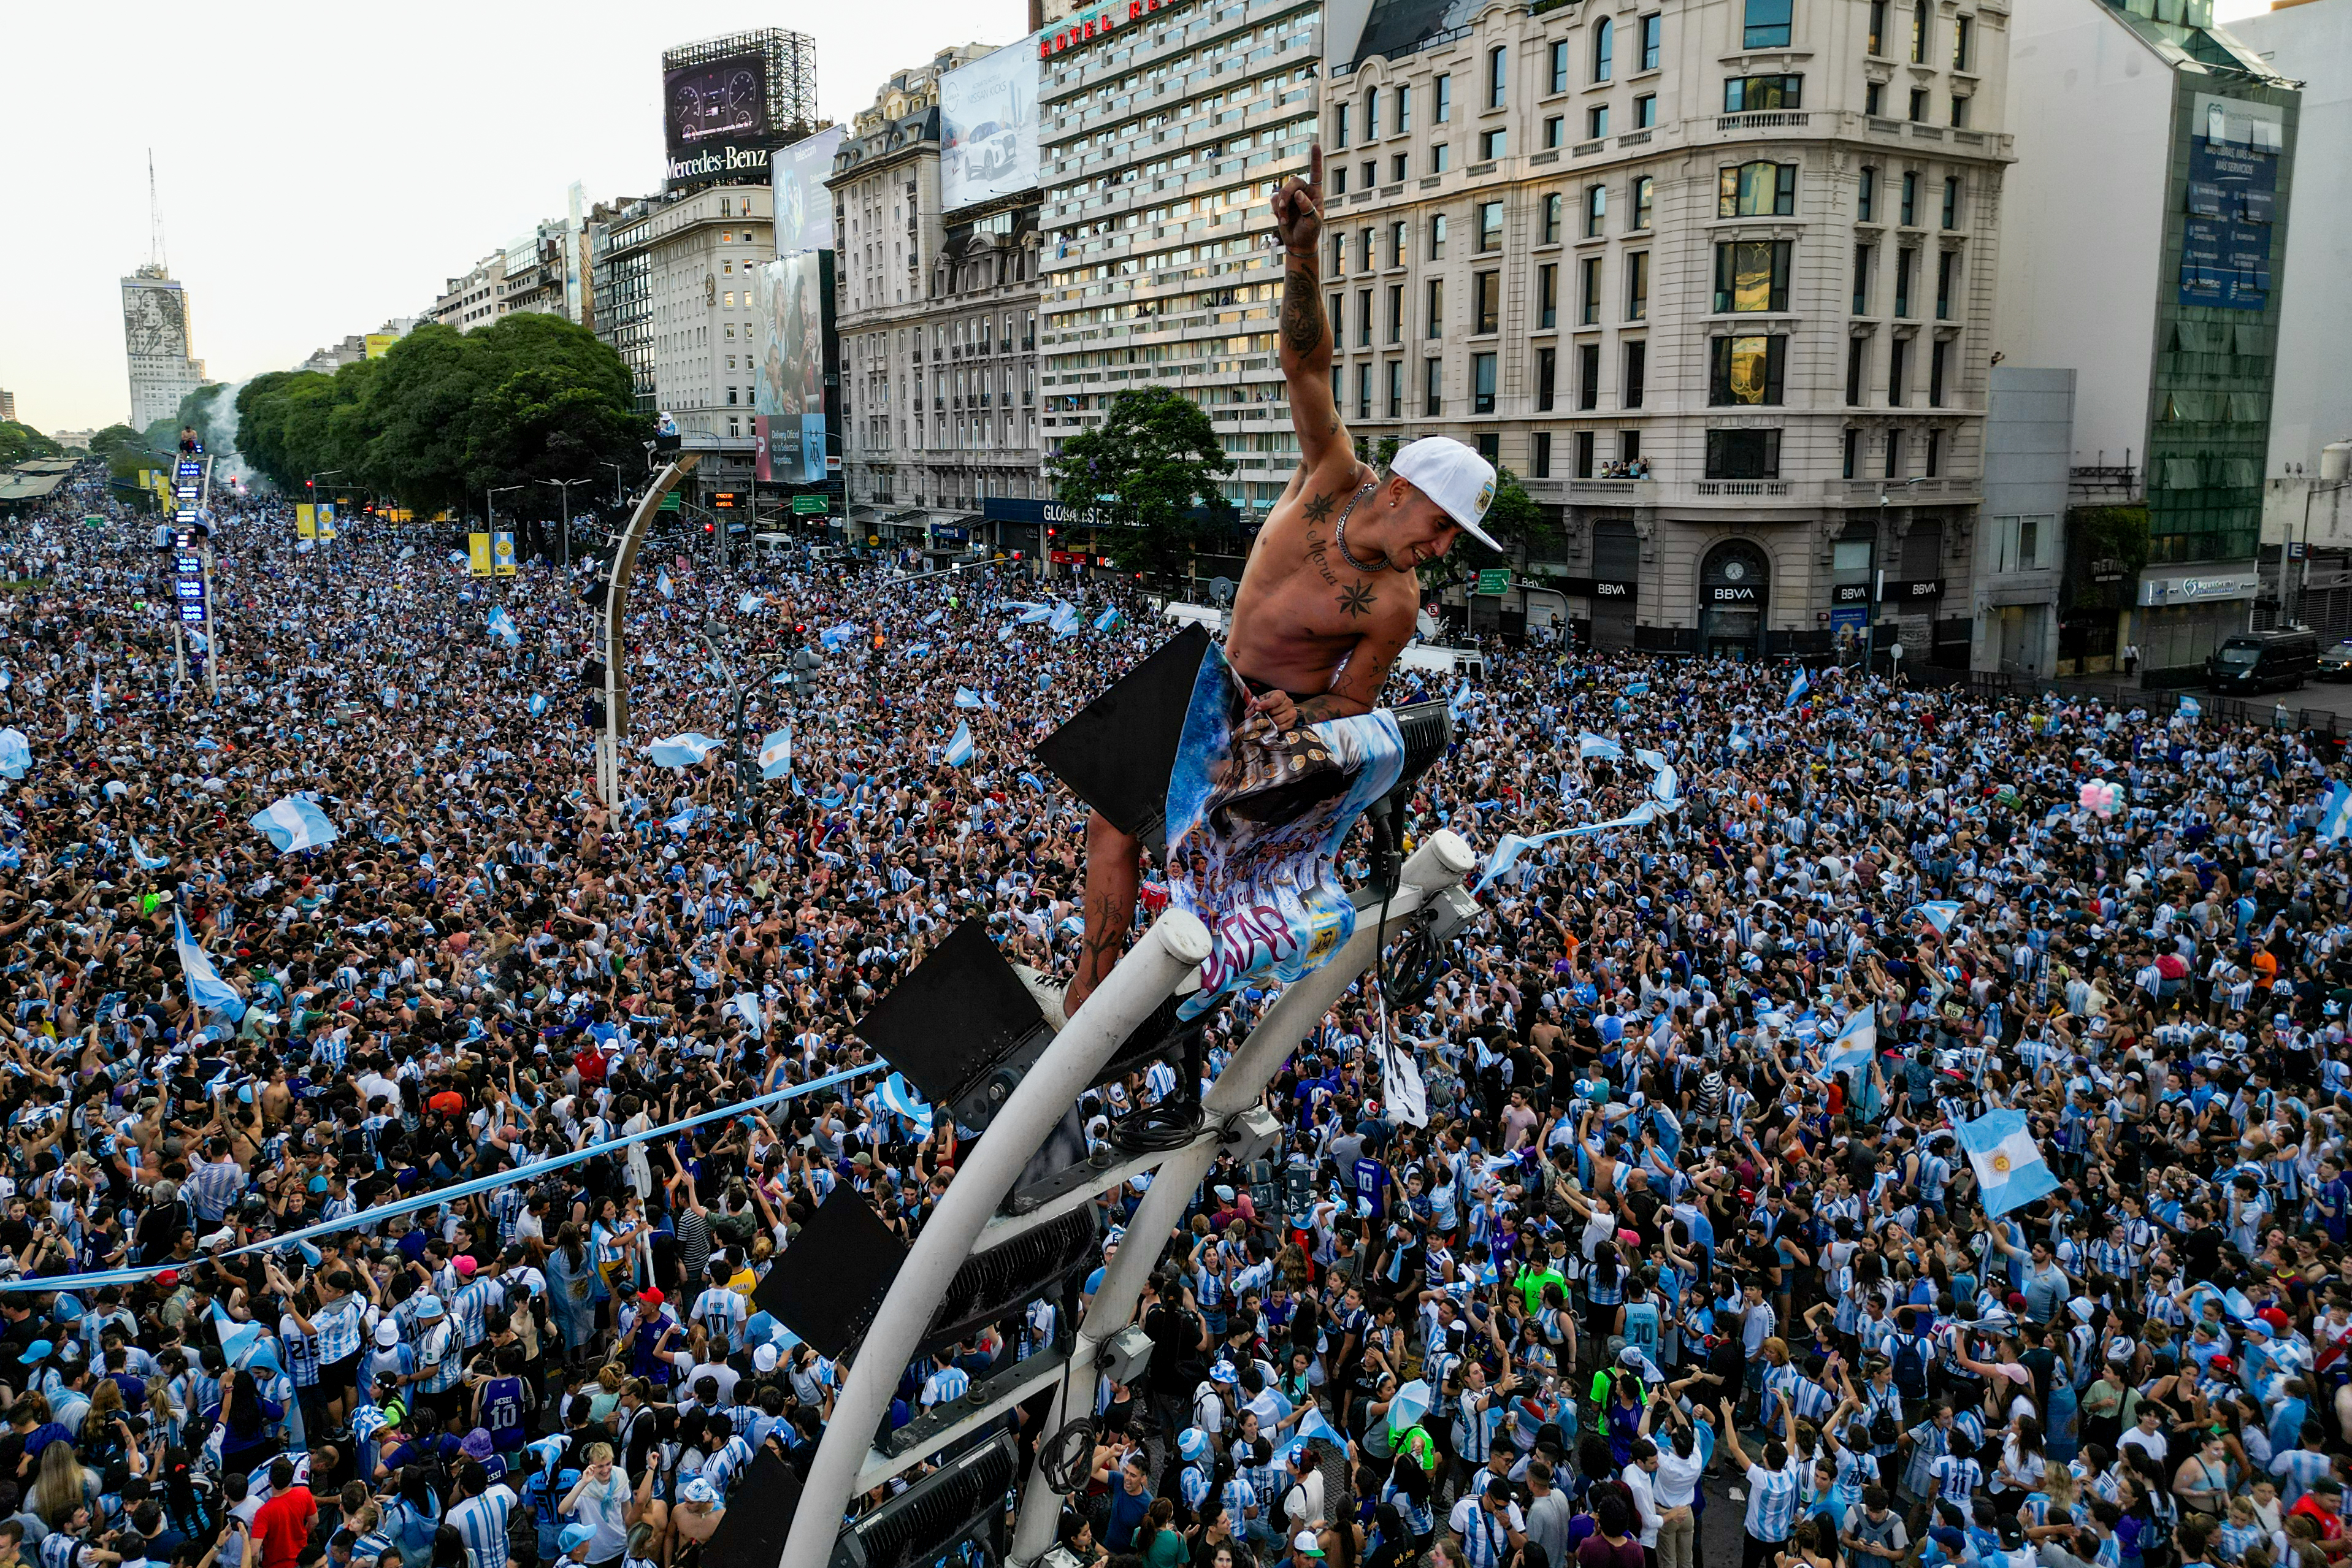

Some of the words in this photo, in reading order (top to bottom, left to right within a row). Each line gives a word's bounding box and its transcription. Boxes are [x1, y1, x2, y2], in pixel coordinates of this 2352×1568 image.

[1041, 15, 1114, 58] HOTEL
[968, 90, 989, 103] NISSAN
[989, 81, 1006, 96] KICKS
[795, 144, 816, 163] telecom
[667, 146, 767, 179] Mercedes-Benz
[2228, 162, 2253, 174] SERVICIOS
[772, 430, 786, 440] Delivery
[787, 429, 799, 438] Oficial
[2291, 544, 2302, 557] E
[1304, 530, 1338, 587] Maria
[1522, 578, 1546, 587] BBV
[1598, 584, 1625, 595] BBVA
[1912, 582, 1936, 595] BBVA
[1714, 587, 1754, 599] BBVA
[1841, 587, 1866, 599] BBVA
[1919, 850, 1928, 860] 10
[1238, 889, 1255, 906] CUP
[1200, 905, 1298, 998] QATAR
[1948, 1009, 1957, 1017] 10
[813, 1180, 822, 1197] 0
[1358, 1171, 1373, 1192] 10
[1212, 1284, 1222, 1293] 10
[709, 1314, 728, 1336] 10
[1633, 1322, 1652, 1344] 10
[494, 1396, 512, 1405] MESSI
[490, 1404, 516, 1431] 10
[488, 1470, 502, 1482] ESSI
[1952, 1475, 1966, 1494] 11
